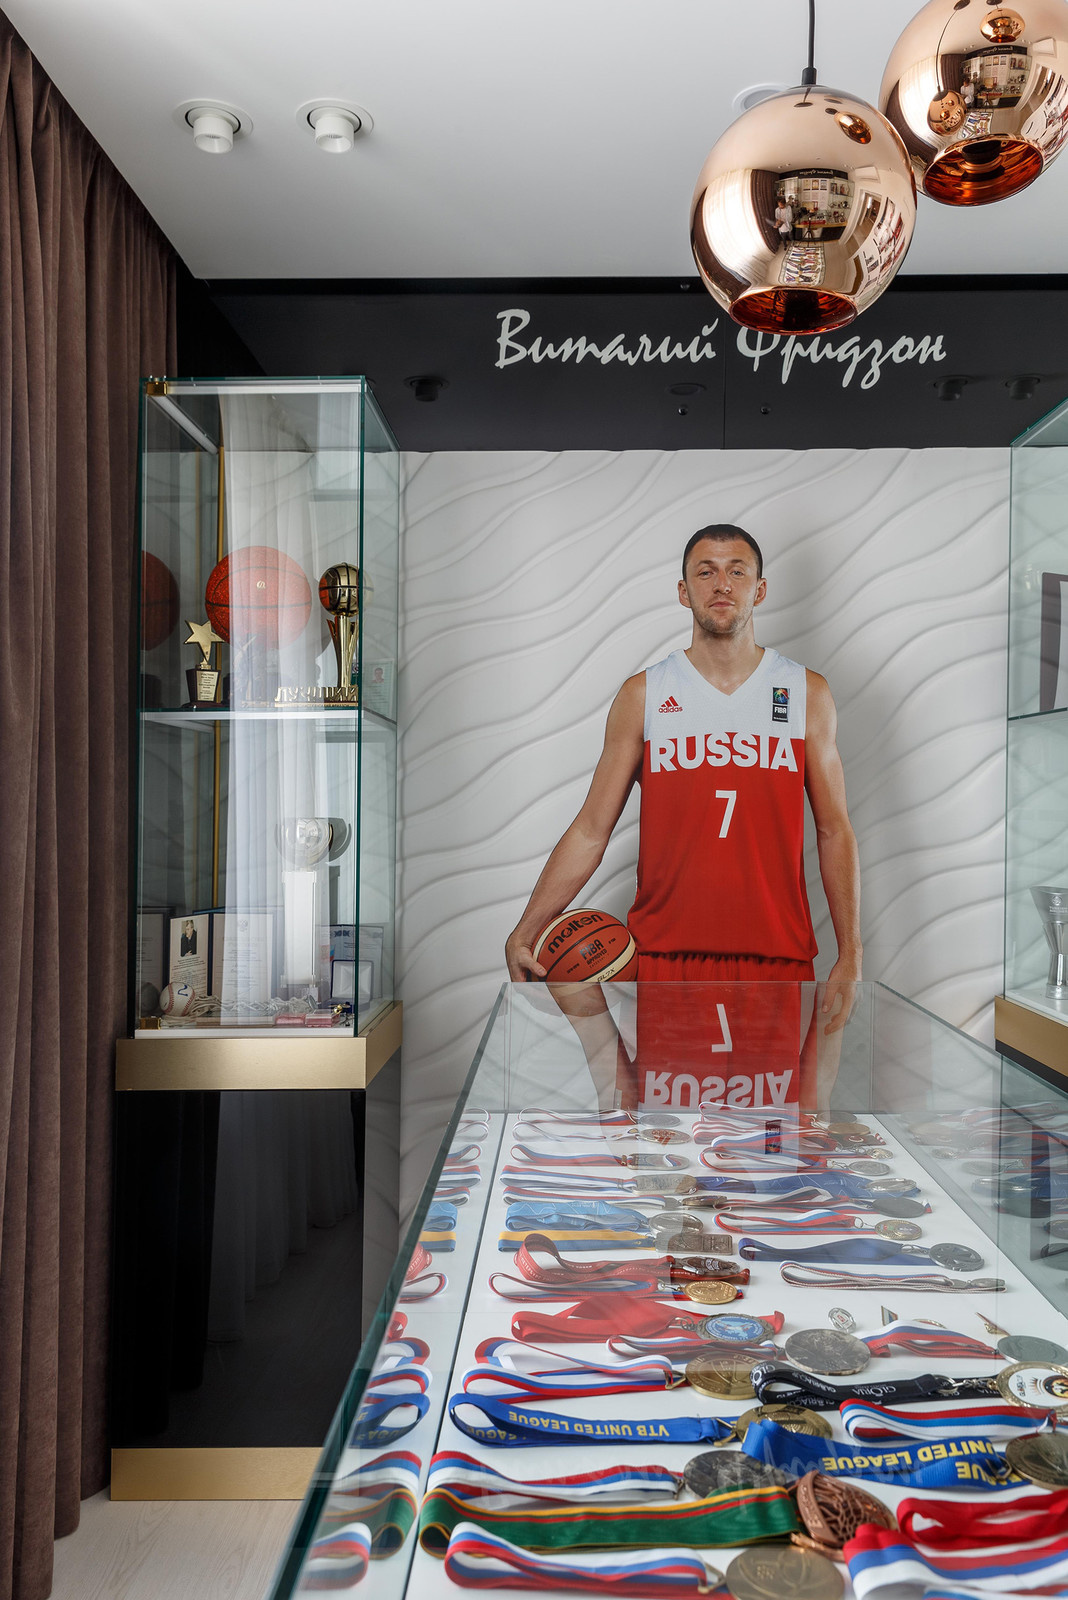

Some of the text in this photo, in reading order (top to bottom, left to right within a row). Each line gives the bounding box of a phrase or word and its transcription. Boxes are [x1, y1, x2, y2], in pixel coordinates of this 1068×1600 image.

[495, 308, 947, 390] Виталий Фридзон
[658, 705, 683, 714] adidas
[774, 706, 787, 714] FIBA
[650, 731, 798, 773] RUSSIA
[715, 789, 737, 838] 7
[547, 914, 604, 954] molten
[579, 939, 604, 961] FIBA
[852, 1385, 897, 1397] GLORIA
[508, 1411, 670, 1437] VTB UNITED LEAGUE
[821, 1450, 912, 1471] LEAGUE
